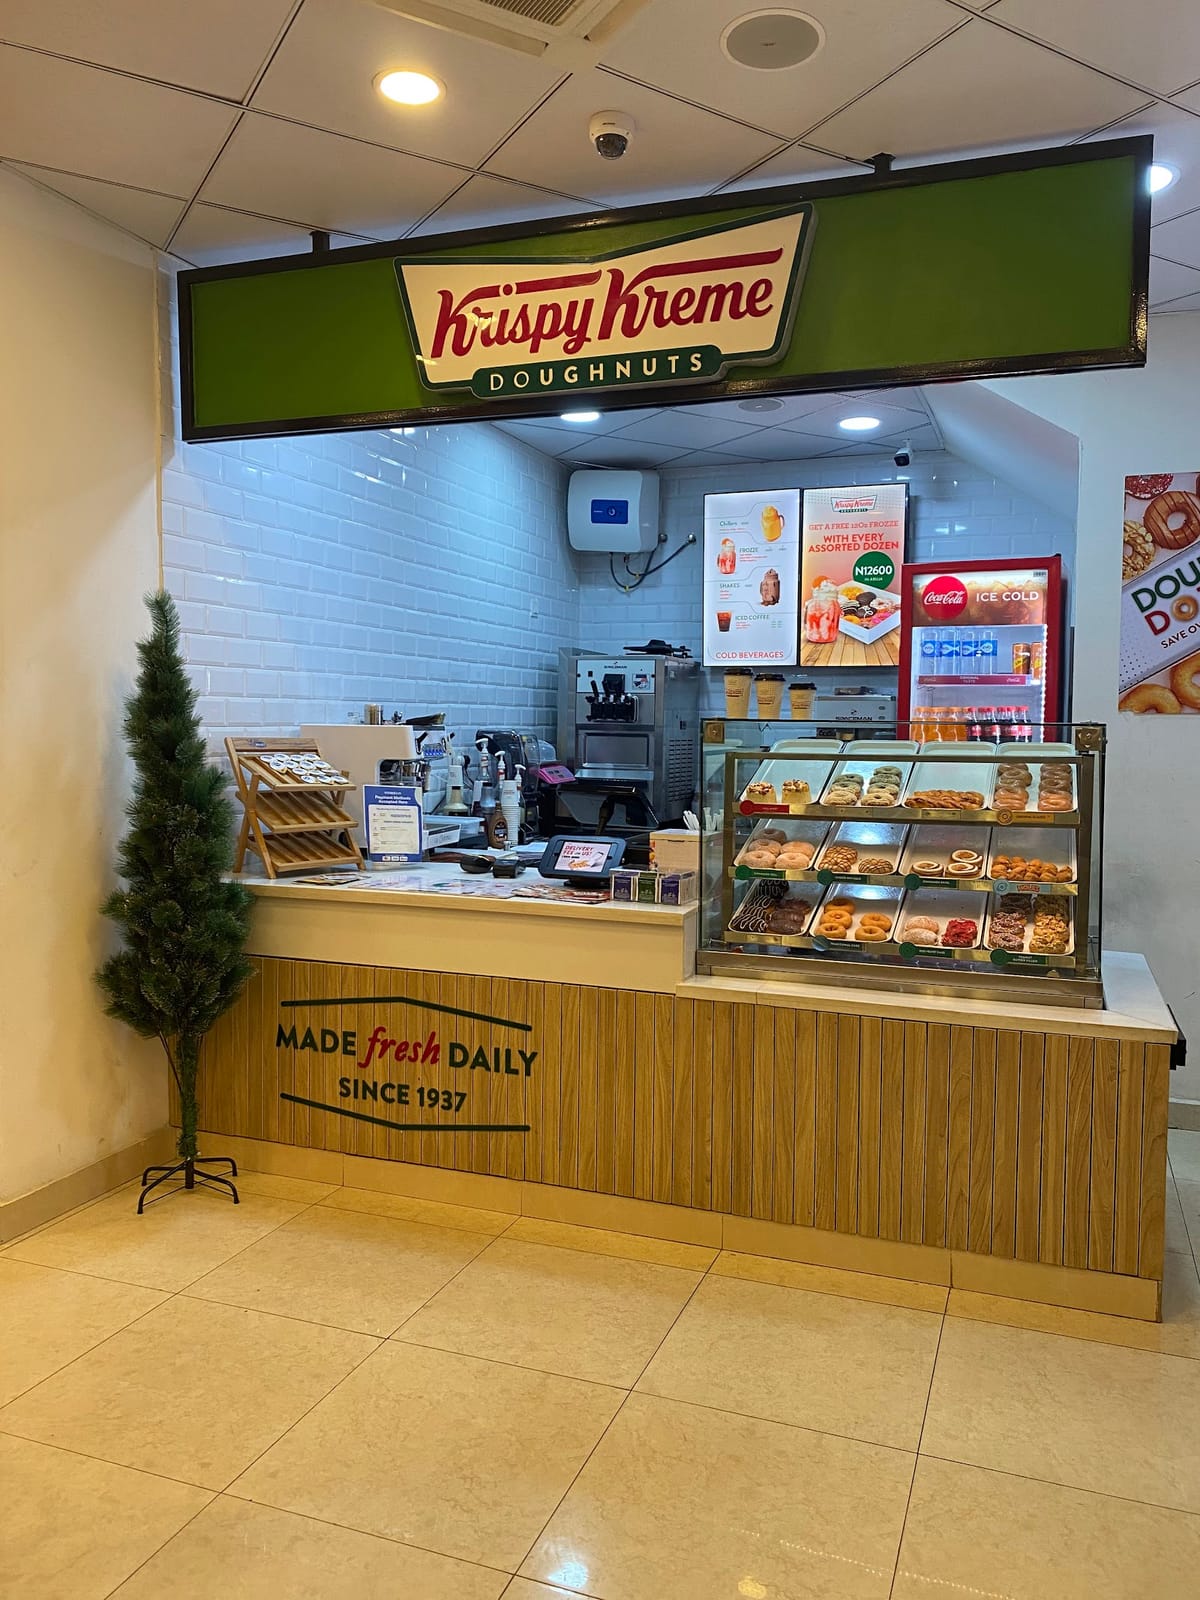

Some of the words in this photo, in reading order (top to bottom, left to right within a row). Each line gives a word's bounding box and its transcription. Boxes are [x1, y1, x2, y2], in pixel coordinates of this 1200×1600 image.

[430, 270, 602, 358] Krispy
[598, 247, 784, 341] Kreme
[489, 352, 703, 392] DOUGHNUTS
[808, 523, 824, 531] GET
[824, 522, 831, 530] A
[831, 522, 850, 530] FREE
[823, 534, 849, 544] WITH
[851, 532, 884, 543] EVERY
[808, 542, 860, 553] ASSORTED
[863, 541, 899, 551] DOZEN
[855, 564, 893, 576] N12600
[1131, 555, 1200, 614] DOU
[924, 590, 966, 605] Coca-Cola
[976, 592, 999, 602] ICE
[1002, 591, 1040, 601] COLD
[1160, 629, 1189, 649] SAVE
[715, 651, 738, 659] COLD
[738, 650, 784, 659] BEVERAGES
[275, 1023, 357, 1056] MADE
[357, 1025, 441, 1070] fresh
[449, 1041, 539, 1077] DAILY
[338, 1076, 410, 1105] SINCE
[417, 1086, 467, 1113] 1937
